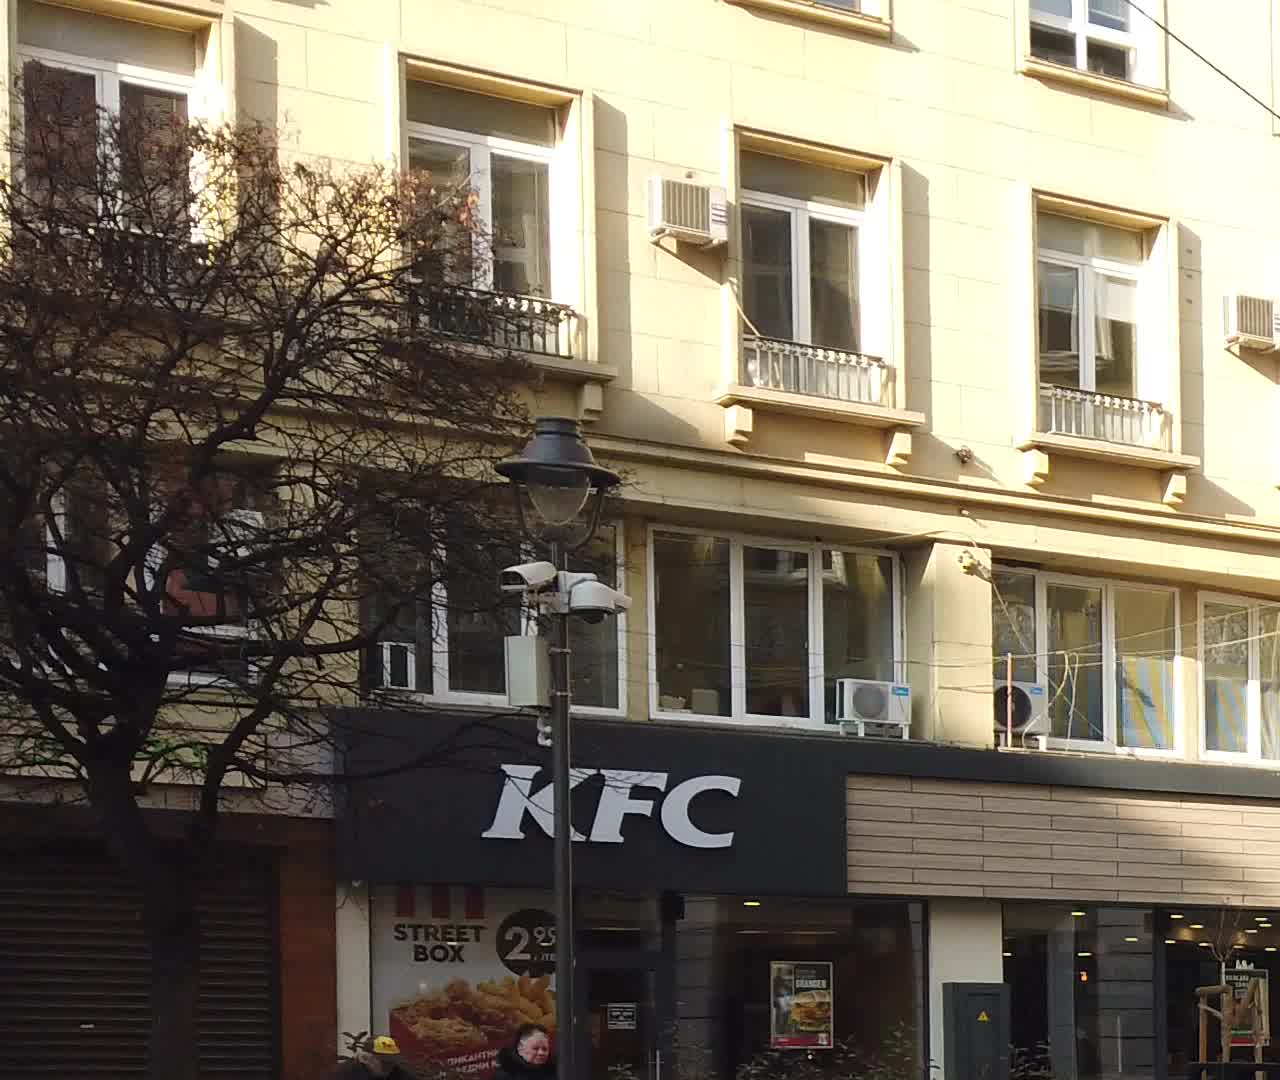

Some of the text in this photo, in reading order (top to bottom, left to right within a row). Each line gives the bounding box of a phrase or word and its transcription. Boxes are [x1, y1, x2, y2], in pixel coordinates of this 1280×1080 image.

[481, 763, 742, 848] KFC
[393, 923, 487, 942] STREET
[414, 944, 465, 962] BOX
